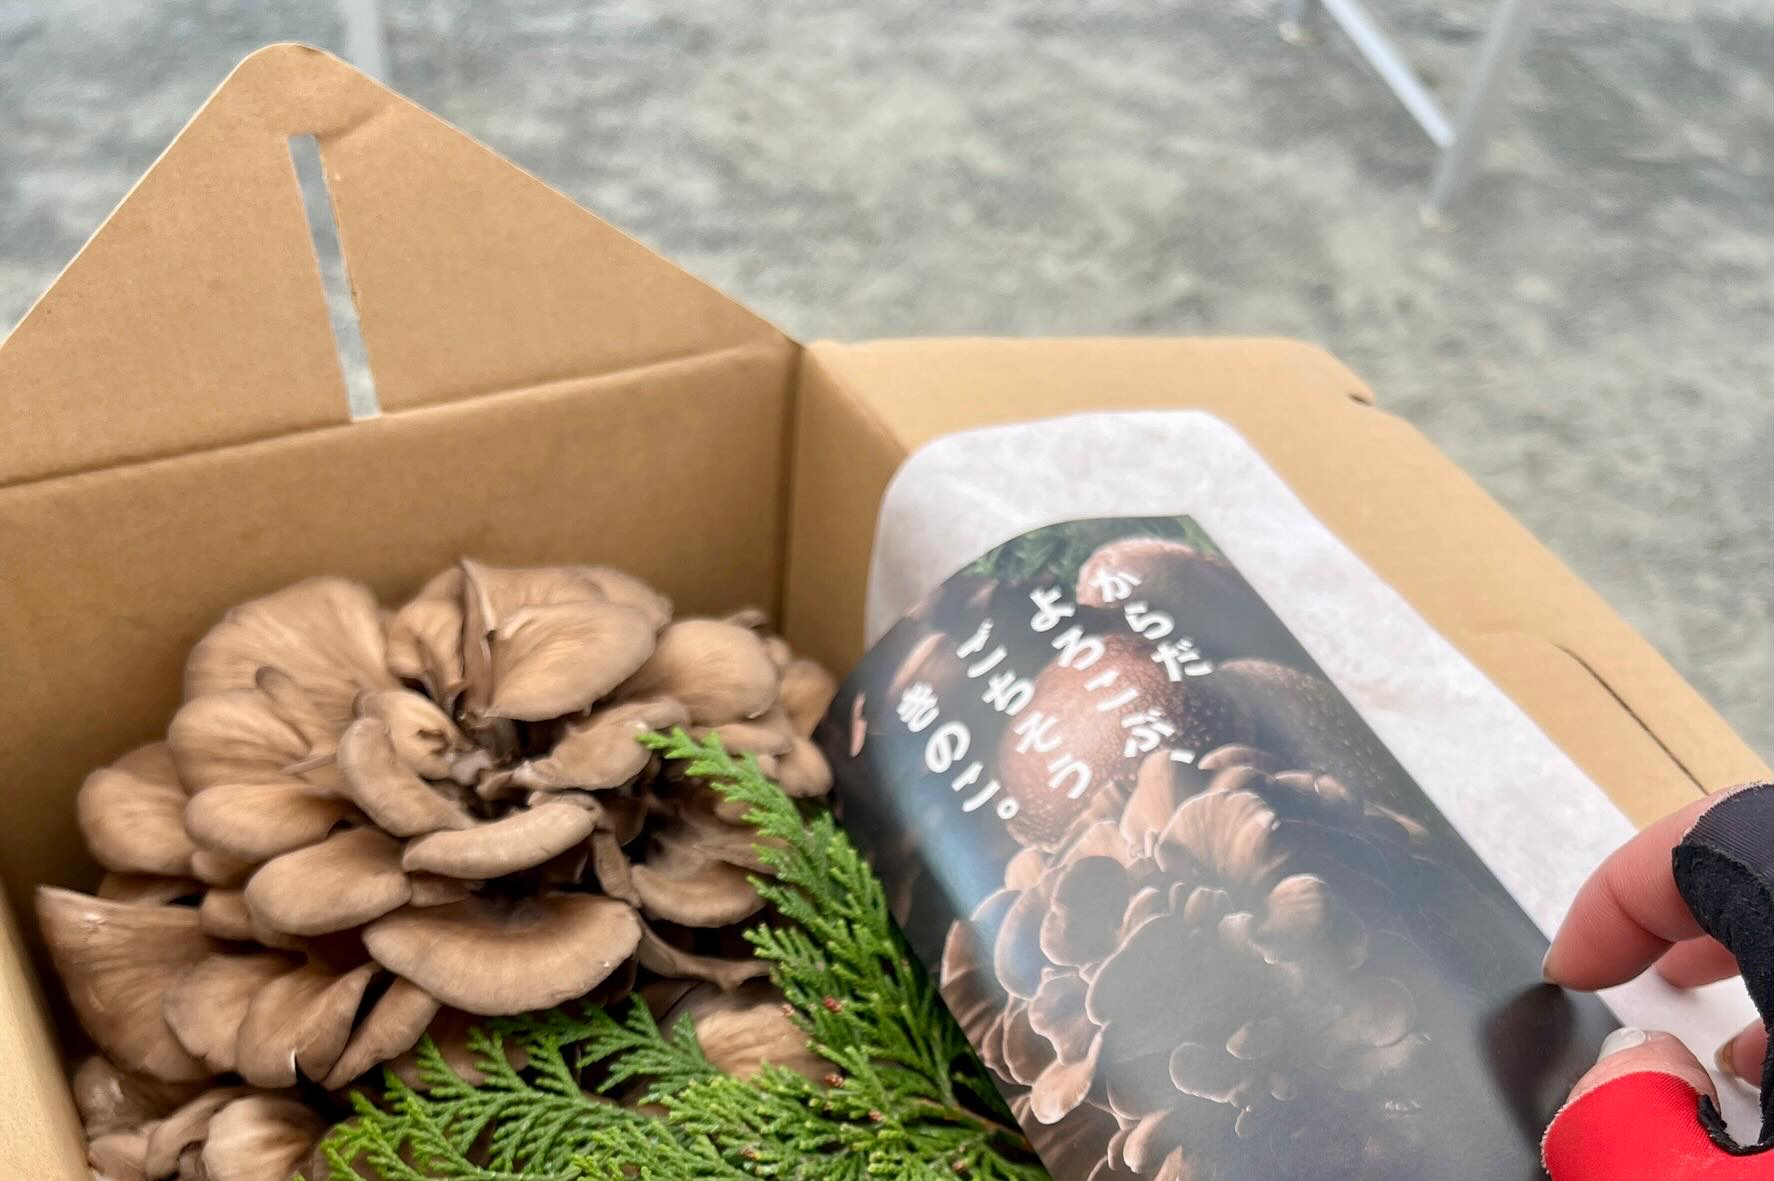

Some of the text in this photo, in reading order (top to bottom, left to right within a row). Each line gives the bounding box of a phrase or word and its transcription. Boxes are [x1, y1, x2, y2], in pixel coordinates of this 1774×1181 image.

[1088, 567, 1213, 683] からだ
[896, 681, 1020, 820] きのこ。
[956, 617, 1093, 799] ごちそう
